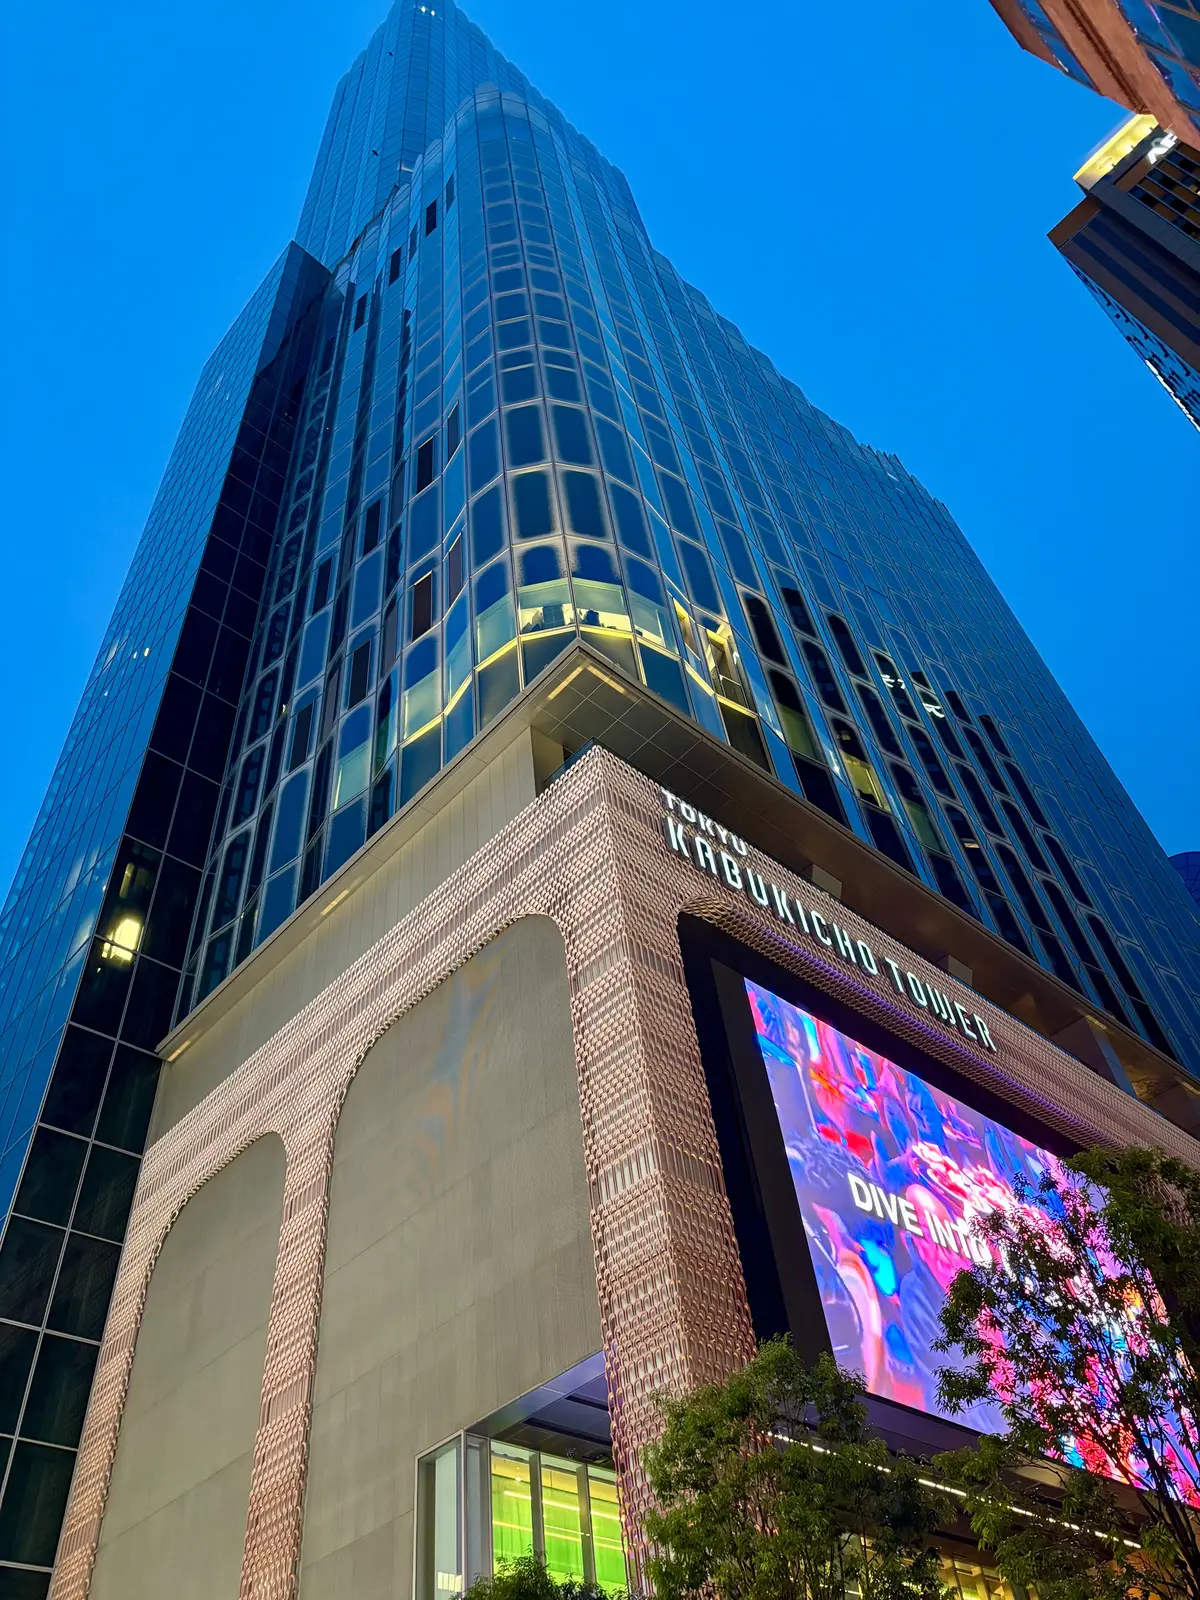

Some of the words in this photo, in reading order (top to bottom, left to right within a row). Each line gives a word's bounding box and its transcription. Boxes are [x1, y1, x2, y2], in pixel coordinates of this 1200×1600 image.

[661, 788, 748, 857] TOKYU
[666, 815, 879, 976] KABUKICHO
[884, 957, 998, 1052] TOWER
[847, 1172, 924, 1236] DIVE
